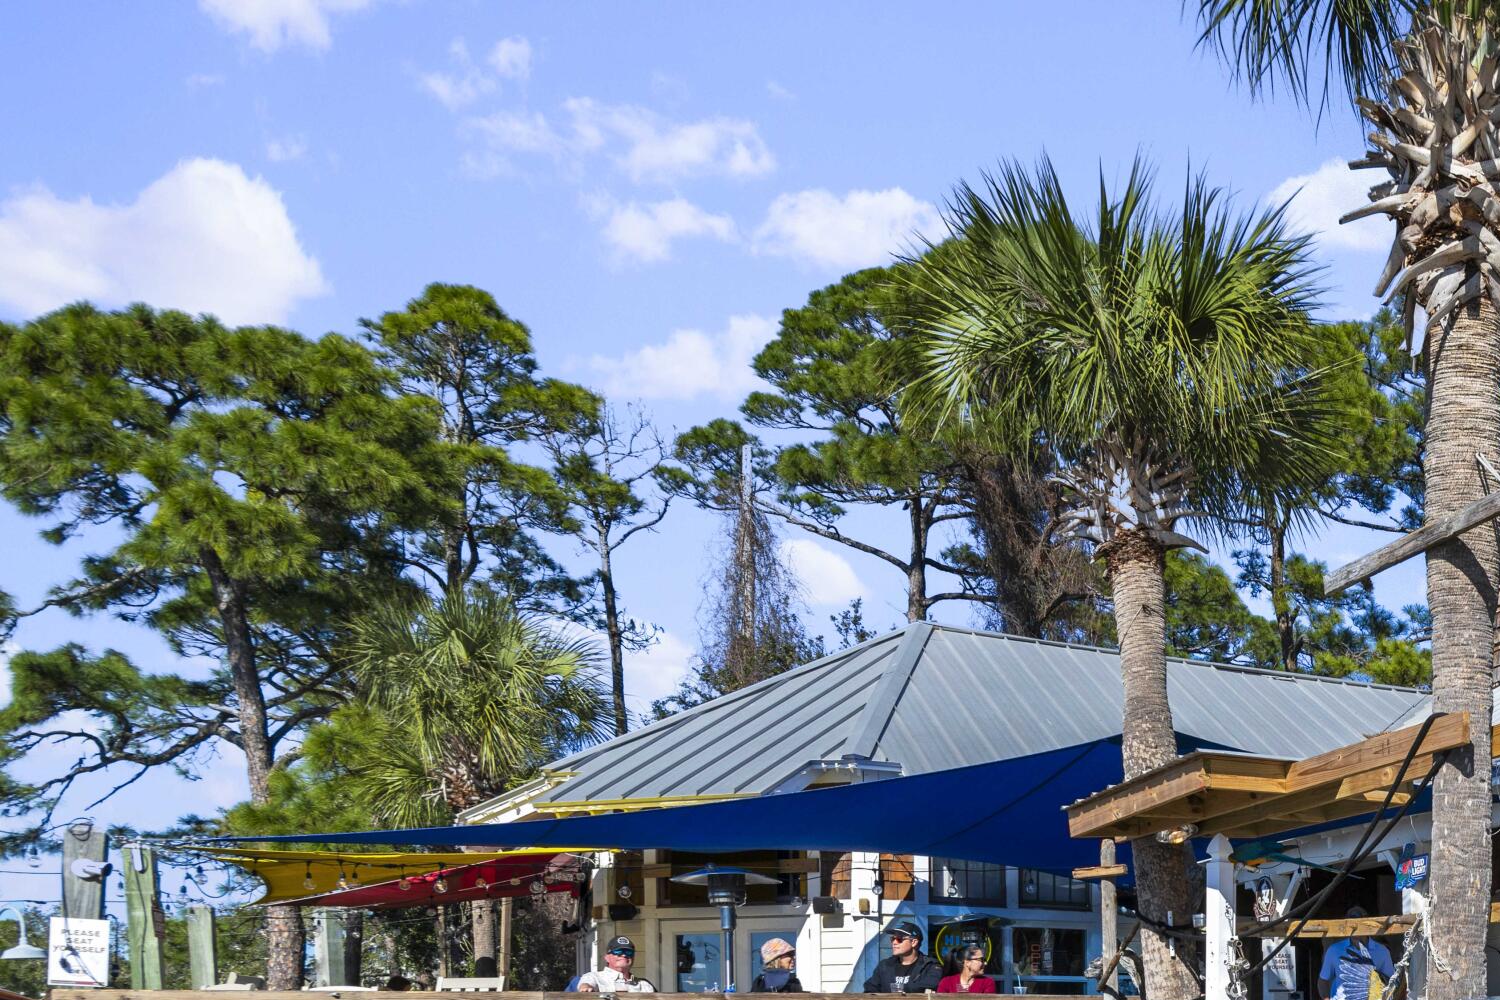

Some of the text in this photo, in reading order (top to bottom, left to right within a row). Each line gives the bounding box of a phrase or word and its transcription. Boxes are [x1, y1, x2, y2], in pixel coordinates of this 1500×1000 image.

[1413, 858, 1425, 867] BUD
[1411, 865, 1426, 875] LIGHT
[61, 929, 101, 938] PLEASE
[65, 937, 93, 945] SEAT
[53, 945, 105, 953] YORSELF
